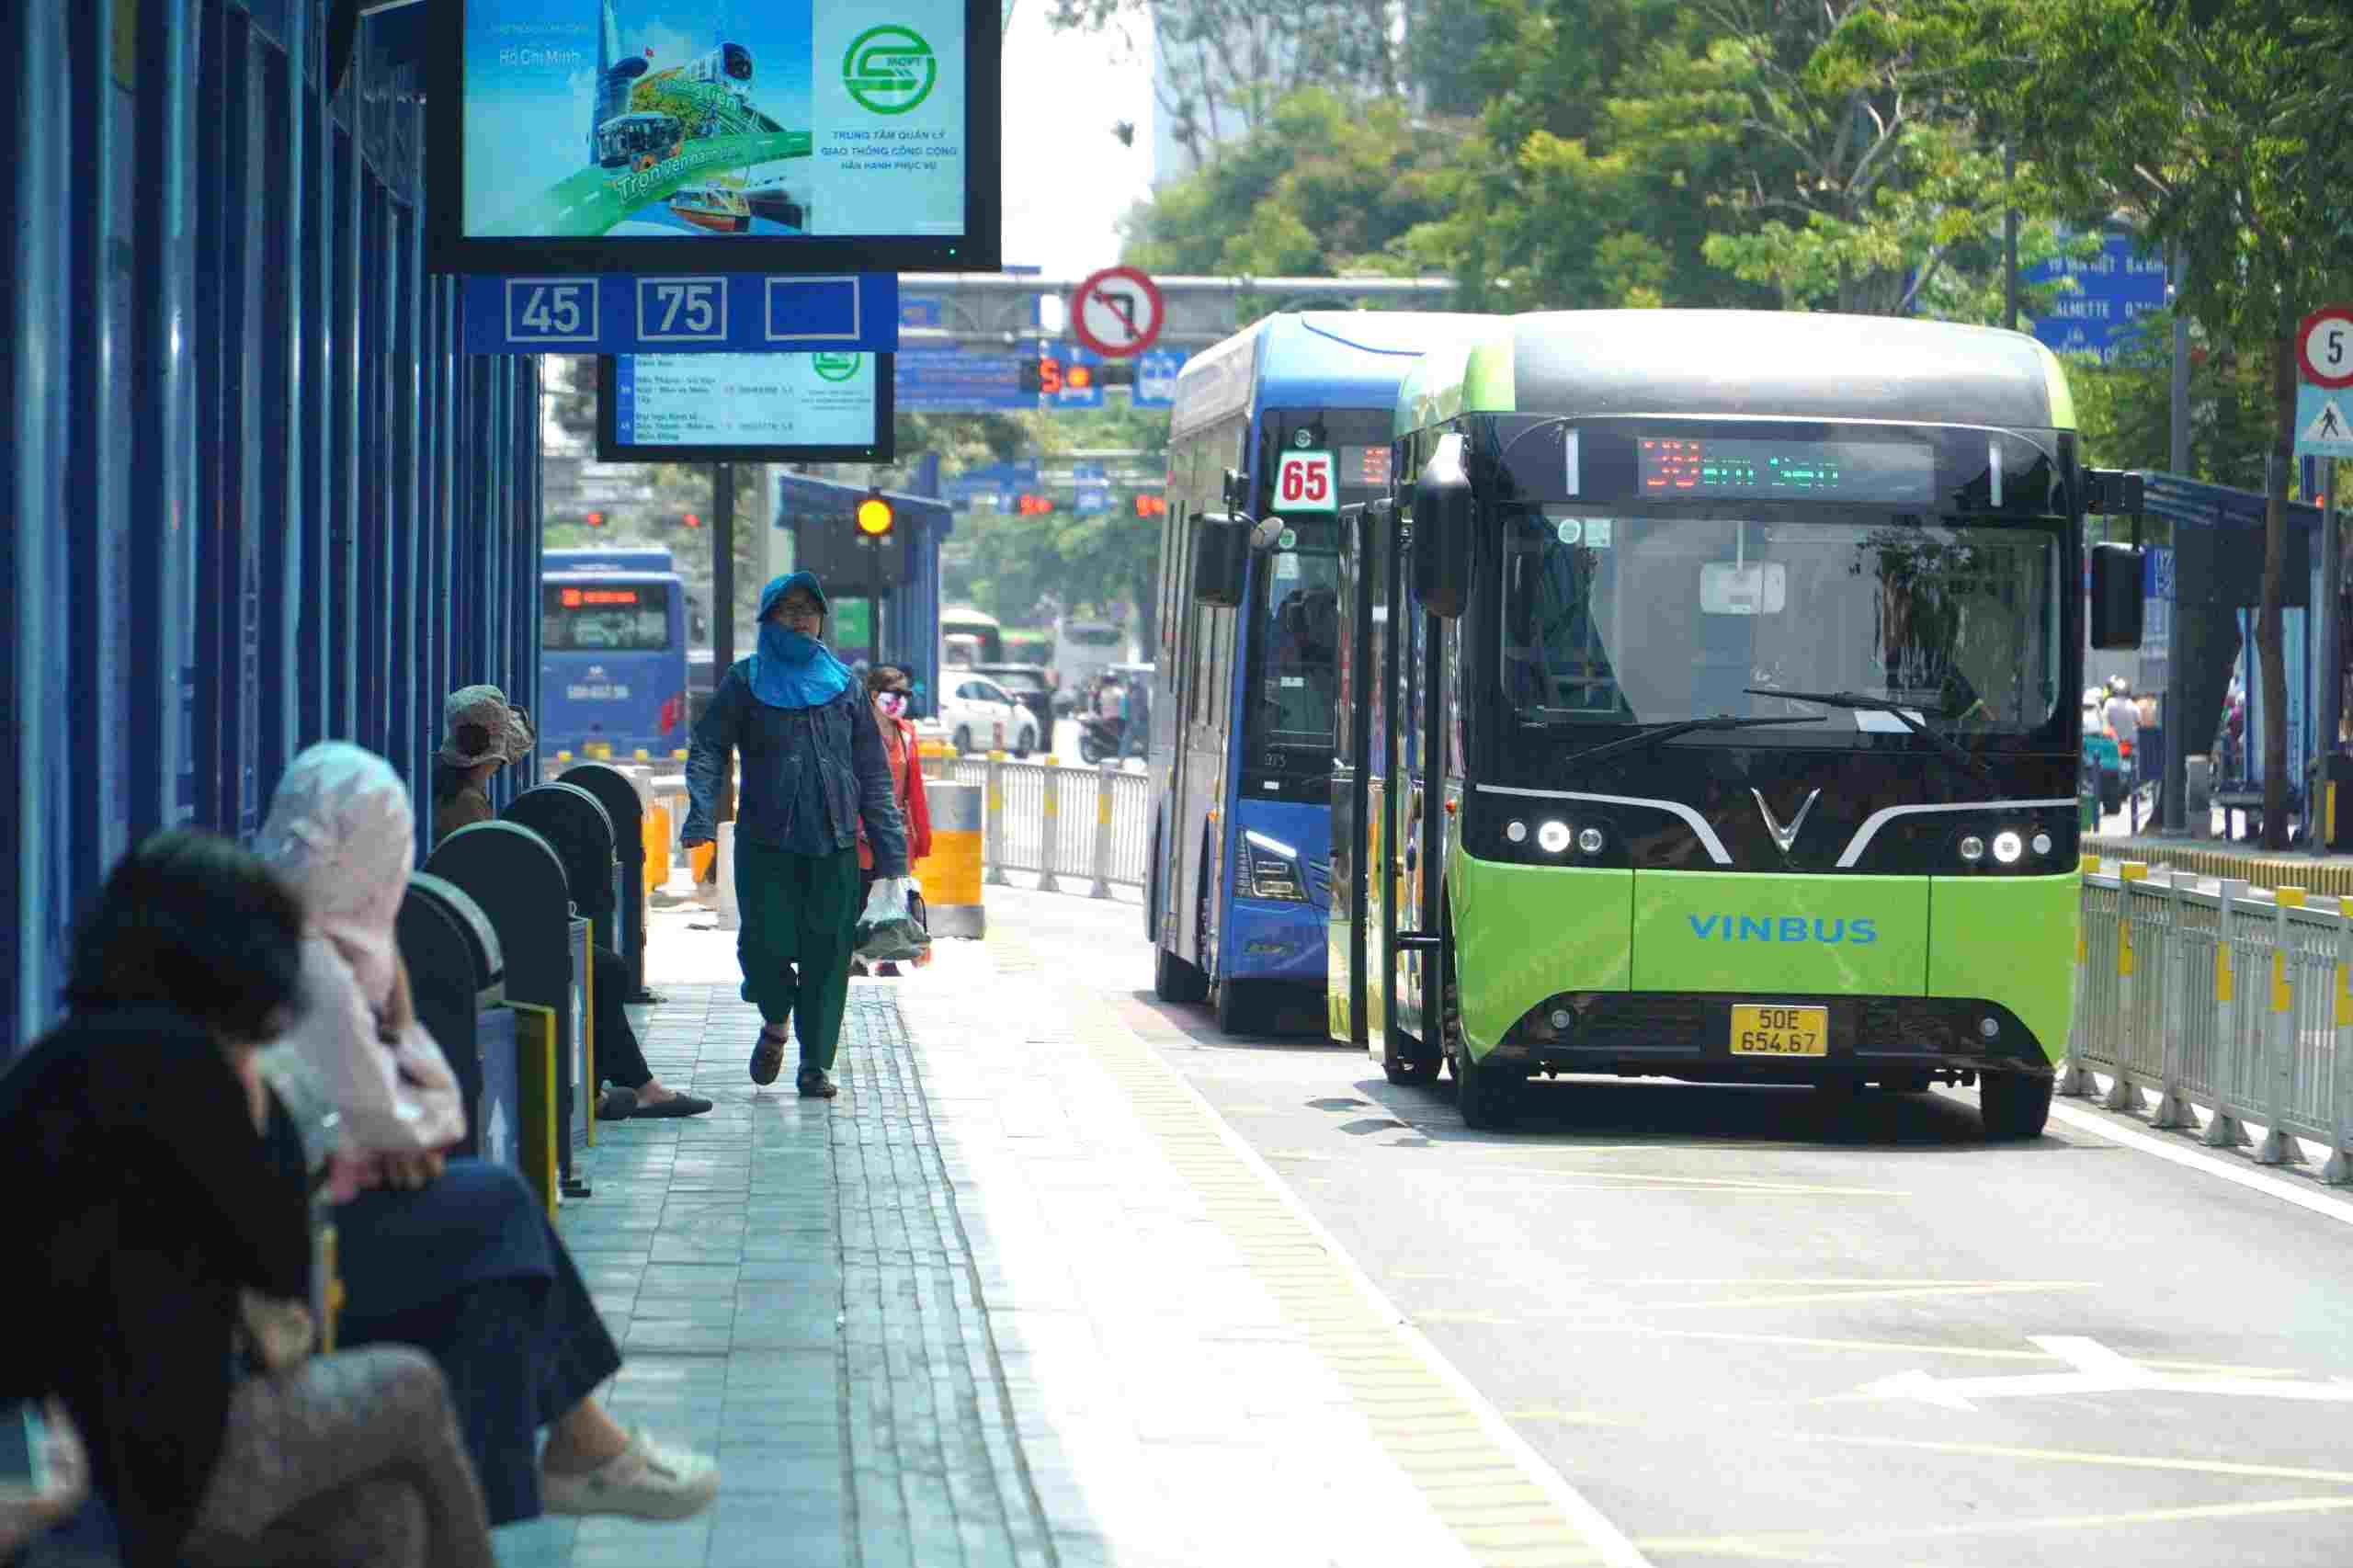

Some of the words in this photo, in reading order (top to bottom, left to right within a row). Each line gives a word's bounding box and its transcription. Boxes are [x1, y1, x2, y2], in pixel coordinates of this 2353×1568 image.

[821, 146, 848, 155] GIAO
[833, 131, 869, 141] TRUNG
[521, 286, 581, 332] 45
[656, 285, 713, 332] 75
[2327, 330, 2345, 364] 5
[1282, 460, 1327, 501] 65
[1688, 915, 1878, 944] VINBUS
[1758, 1009, 1800, 1030] 50E
